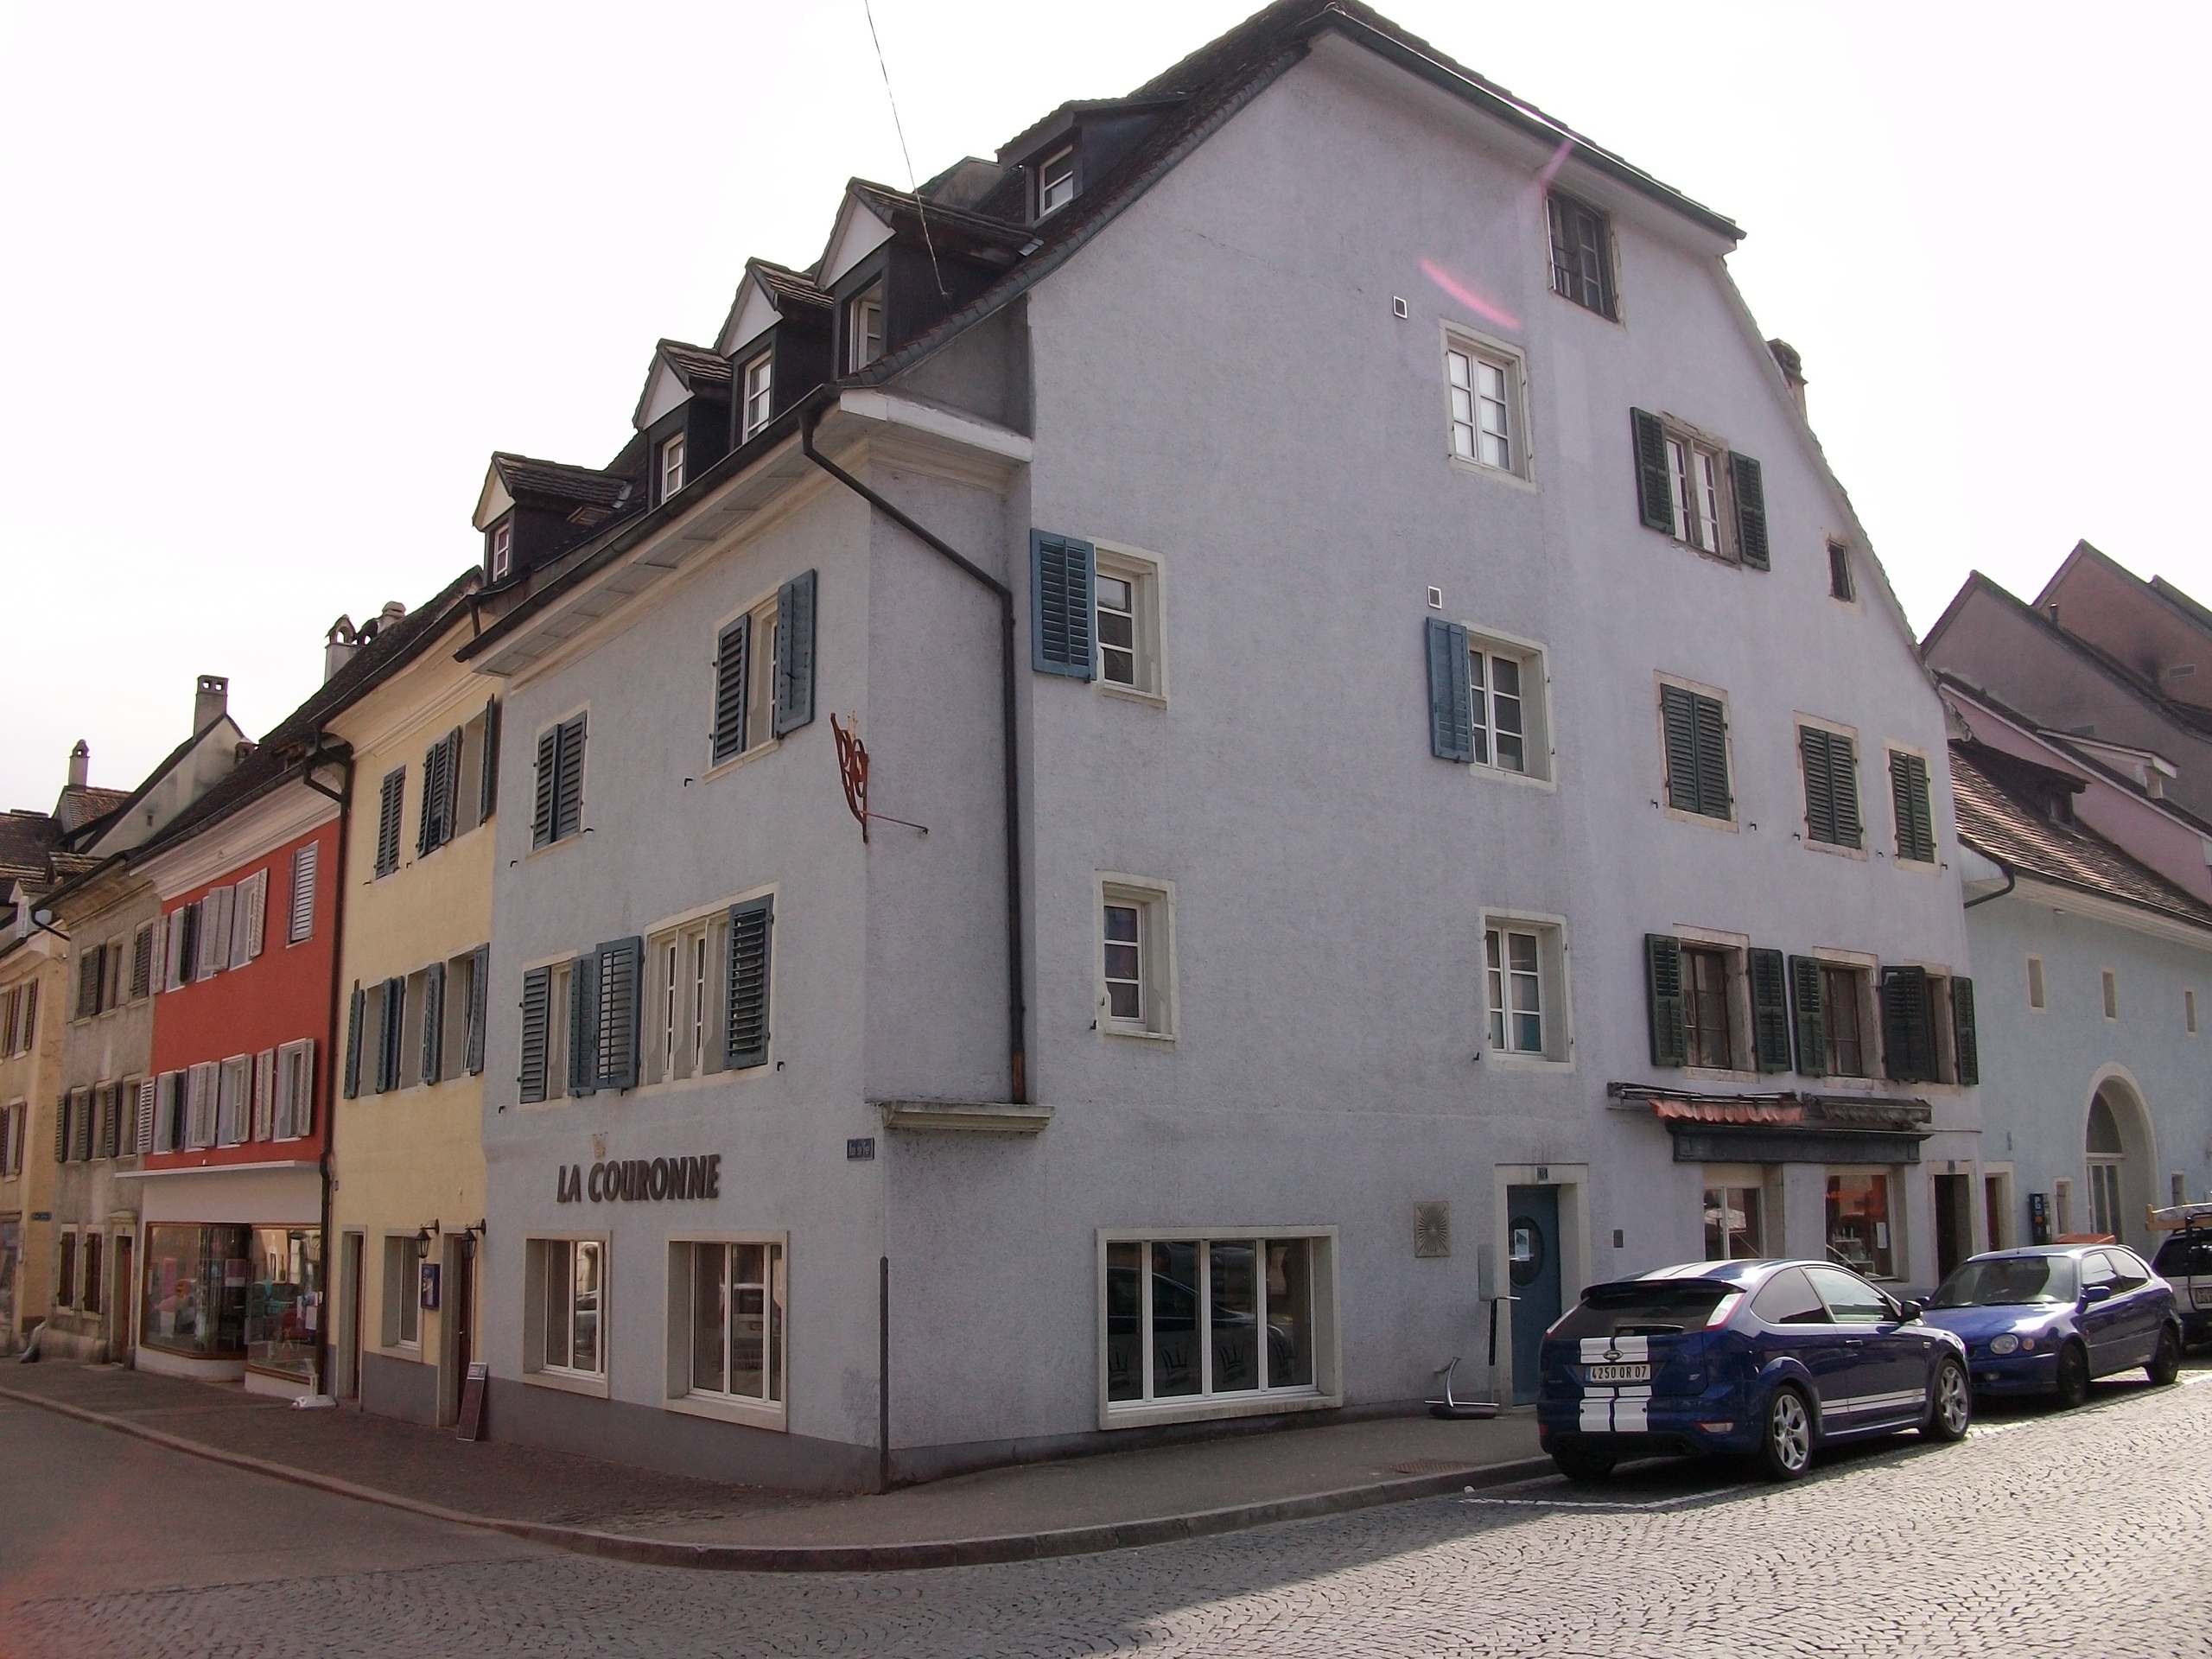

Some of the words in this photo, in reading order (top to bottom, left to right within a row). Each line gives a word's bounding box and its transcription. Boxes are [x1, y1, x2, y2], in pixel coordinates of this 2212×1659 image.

[556, 1164, 582, 1203] LA
[588, 1154, 721, 1202] COURONNE
[1592, 1366, 1616, 1379] 4250
[1635, 1365, 1647, 1378] 07
